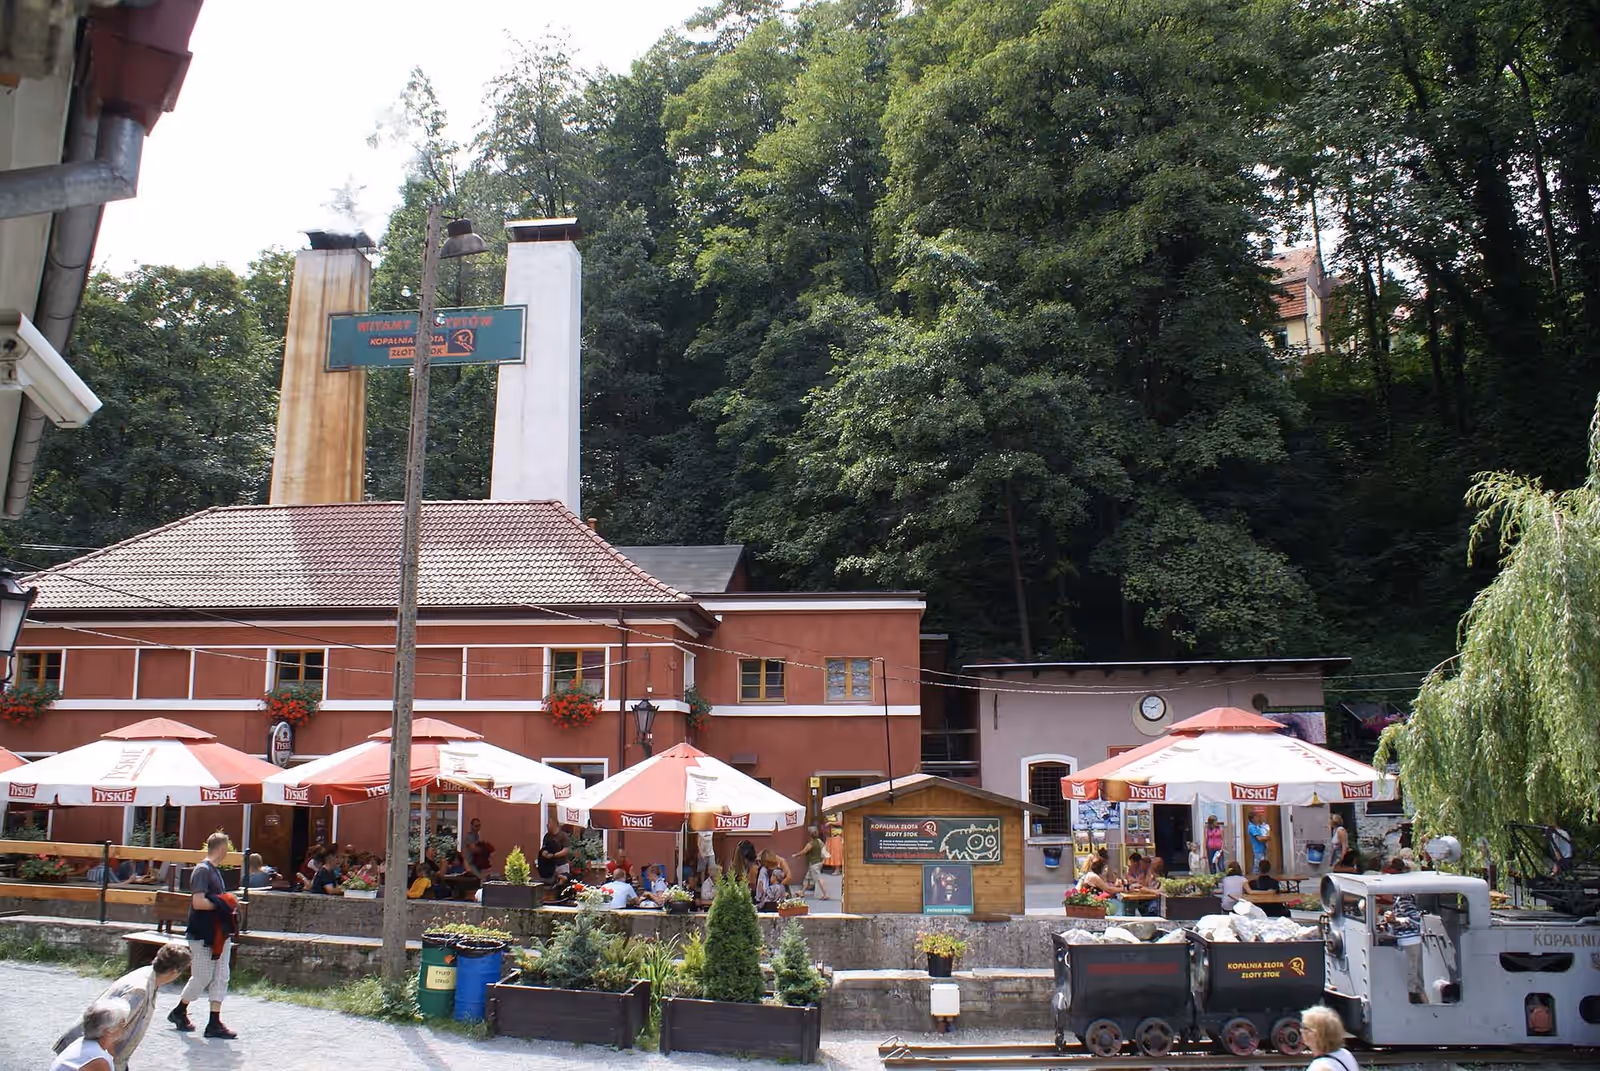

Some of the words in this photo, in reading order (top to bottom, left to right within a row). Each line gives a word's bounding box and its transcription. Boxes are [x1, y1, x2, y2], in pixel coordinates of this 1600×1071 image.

[357, 320, 412, 332] WITAMY
[370, 336, 414, 346] KOPALNIA
[10, 784, 35, 797] TYSKIE
[94, 789, 133, 802] TYSKIE
[202, 788, 237, 800] TYSKIE
[285, 788, 309, 800] TYSKIE
[1129, 785, 1164, 799] TYSKIE
[1234, 786, 1276, 800] TYSKIE
[1343, 785, 1372, 798] TYSKIE
[621, 815, 653, 827] TYSKIE
[716, 816, 748, 828] TYSKIE
[1227, 962, 1262, 970] KOPALNIA
[1263, 961, 1285, 969] ZŁOTA
[1241, 971, 1261, 979] ZŁOTY
[1262, 970, 1281, 978] STOK
